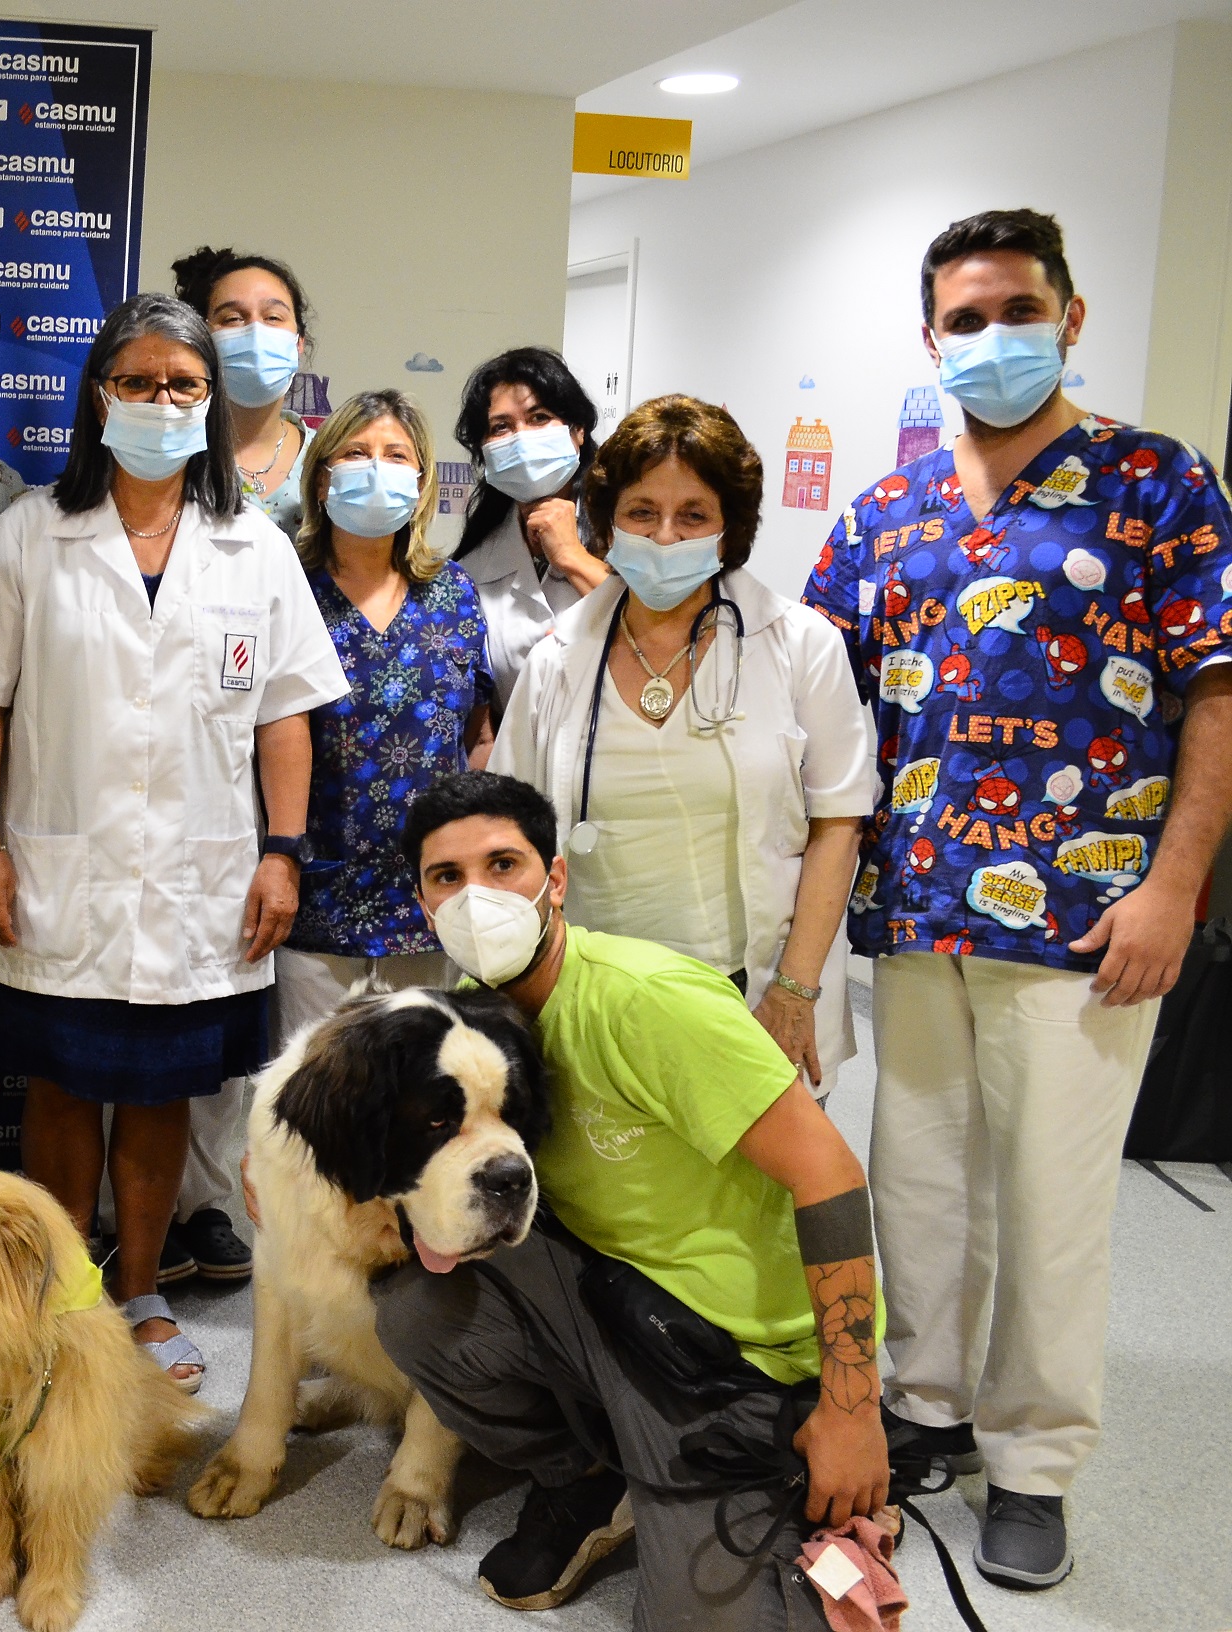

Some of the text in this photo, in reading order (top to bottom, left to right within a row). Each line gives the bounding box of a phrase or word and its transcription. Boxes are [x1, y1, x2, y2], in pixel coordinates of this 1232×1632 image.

[30, 74, 47, 82] para
[48, 74, 78, 83] cuidarte
[35, 102, 116, 123] casmu
[35, 121, 115, 133] estamos para cuidarte
[609, 150, 684, 173] LOCUTORIO
[44, 175, 74, 184] cuidarte
[31, 209, 111, 230] casmu
[30, 228, 110, 239] estamos para cuidarte
[22, 281, 38, 289] para
[40, 281, 70, 290] cuidarte
[26, 334, 57, 342] estamos
[76, 336, 96, 344] cuida
[35, 393, 64, 401] cuidarte
[959, 581, 1046, 635] ZZIPP!
[949, 714, 1059, 749] LET'S
[937, 803, 1057, 851] HANG
[1052, 836, 1142, 875] THWIP!
[981, 871, 1046, 901] SPIDEY
[1010, 869, 1028, 882] My
[980, 884, 1037, 913] SENSE
[979, 898, 1031, 923] is tingling
